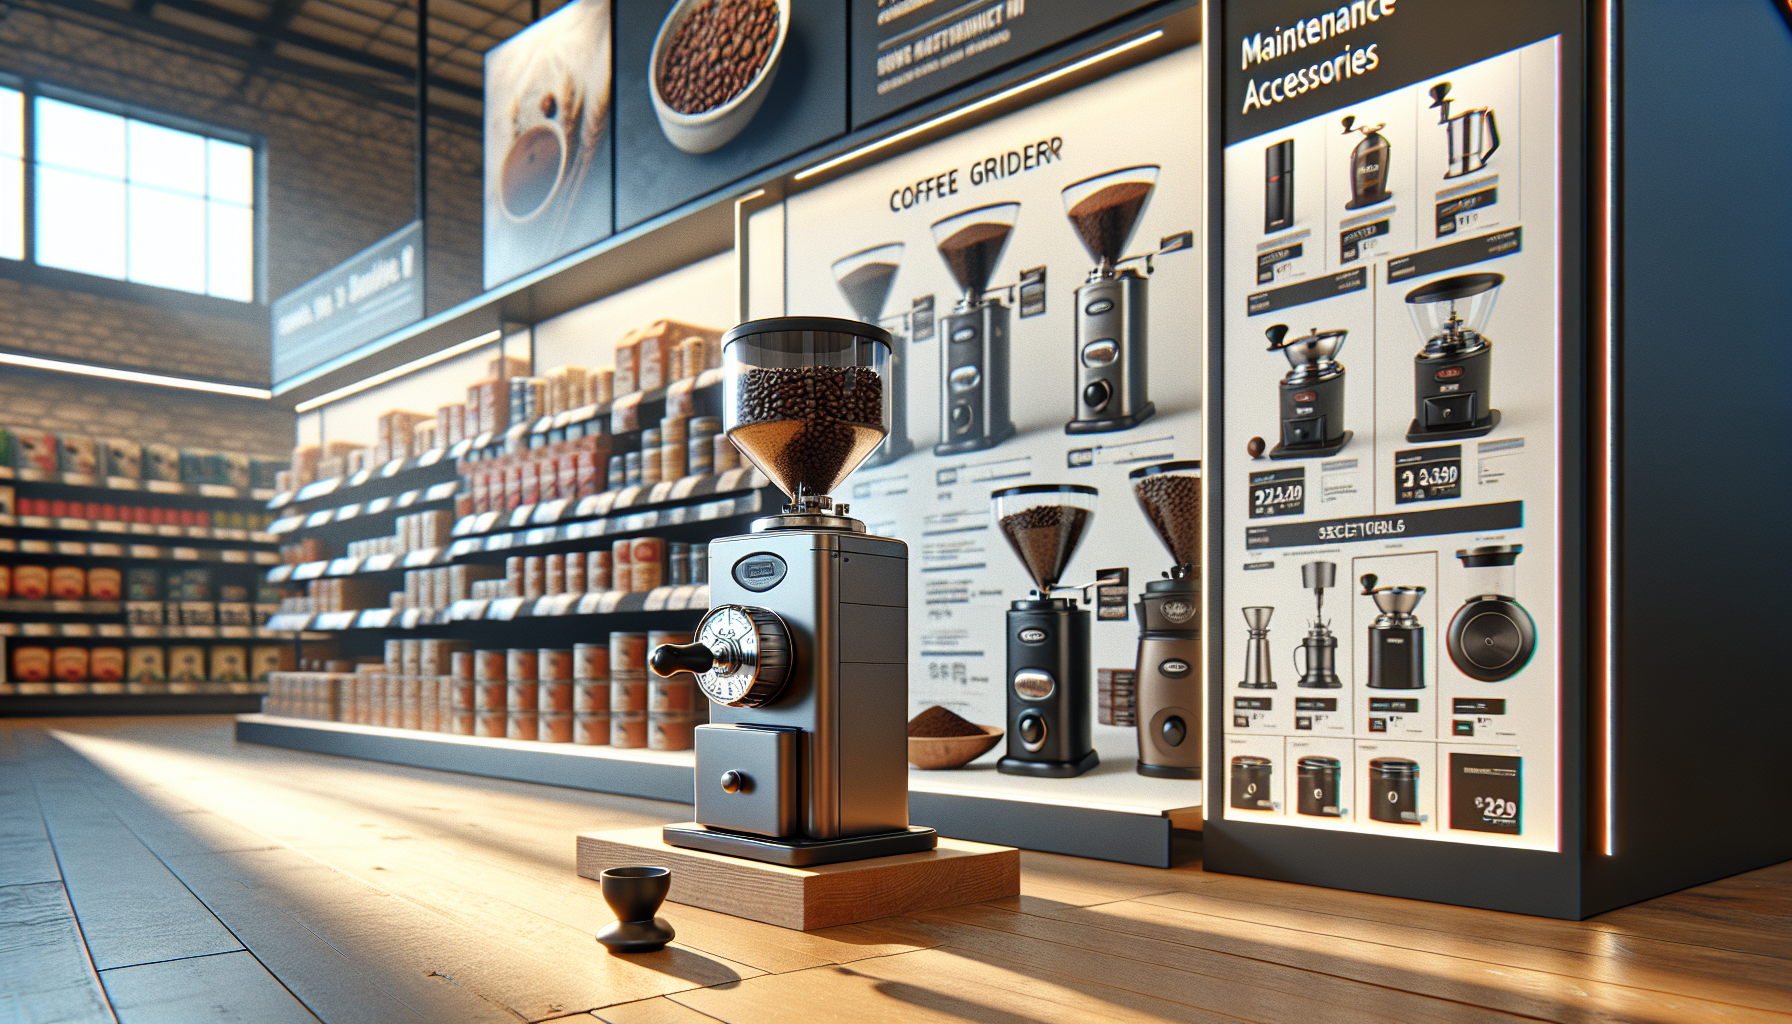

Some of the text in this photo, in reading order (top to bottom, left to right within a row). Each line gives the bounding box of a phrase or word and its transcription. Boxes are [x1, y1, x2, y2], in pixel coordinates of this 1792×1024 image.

[1241, 0, 1396, 71] Maintenance
[1241, 43, 1380, 115] Accessories
[889, 168, 959, 213] COFFEE
